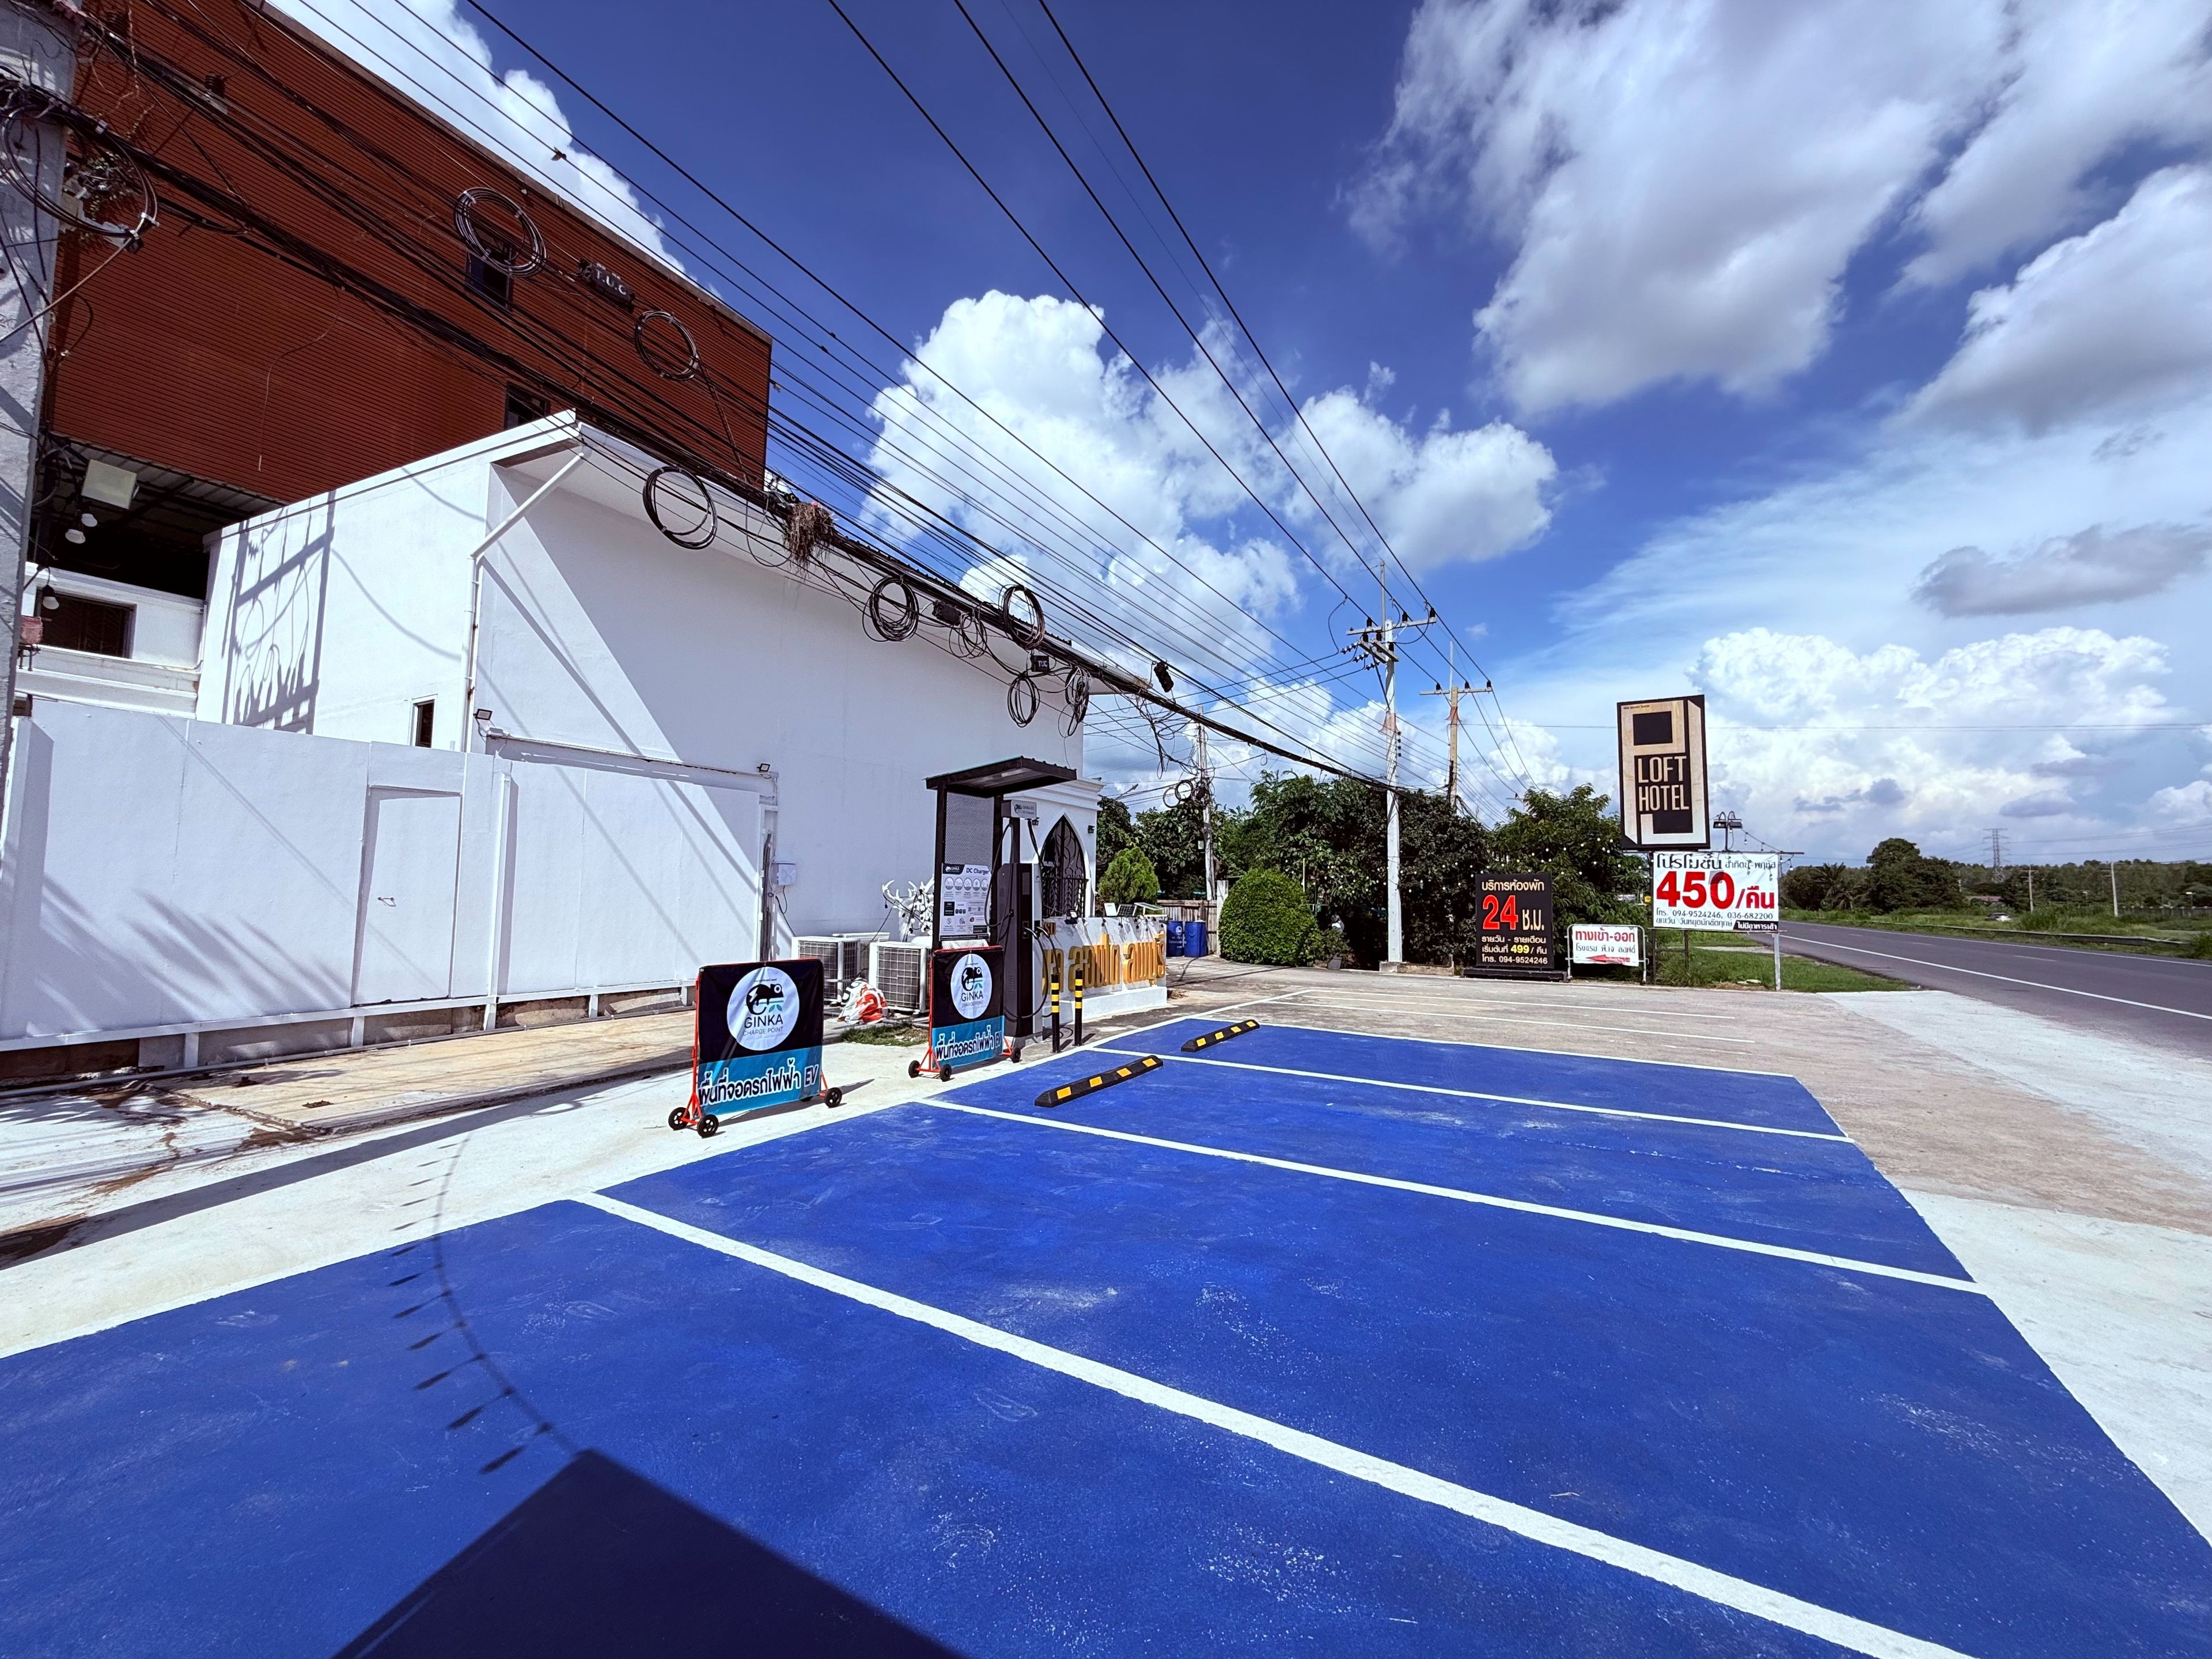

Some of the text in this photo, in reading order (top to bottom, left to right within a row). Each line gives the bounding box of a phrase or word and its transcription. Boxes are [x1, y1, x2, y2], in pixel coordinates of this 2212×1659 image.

[1638, 755, 1687, 783] LOFT
[1639, 784, 1690, 812] HOTEL
[1482, 879, 1545, 891] บริการห้องพัก
[1483, 895, 1518, 930] 24
[1727, 911, 1773, 919] 036-682200
[1510, 945, 1530, 953] 499
[1482, 954, 1548, 964] โทร. 094-9524246
[961, 990, 984, 1002] GINKA
[744, 1014, 783, 1029] GINKA
[743, 1027, 766, 1036] CHARGE
[804, 1064, 819, 1087] EV
